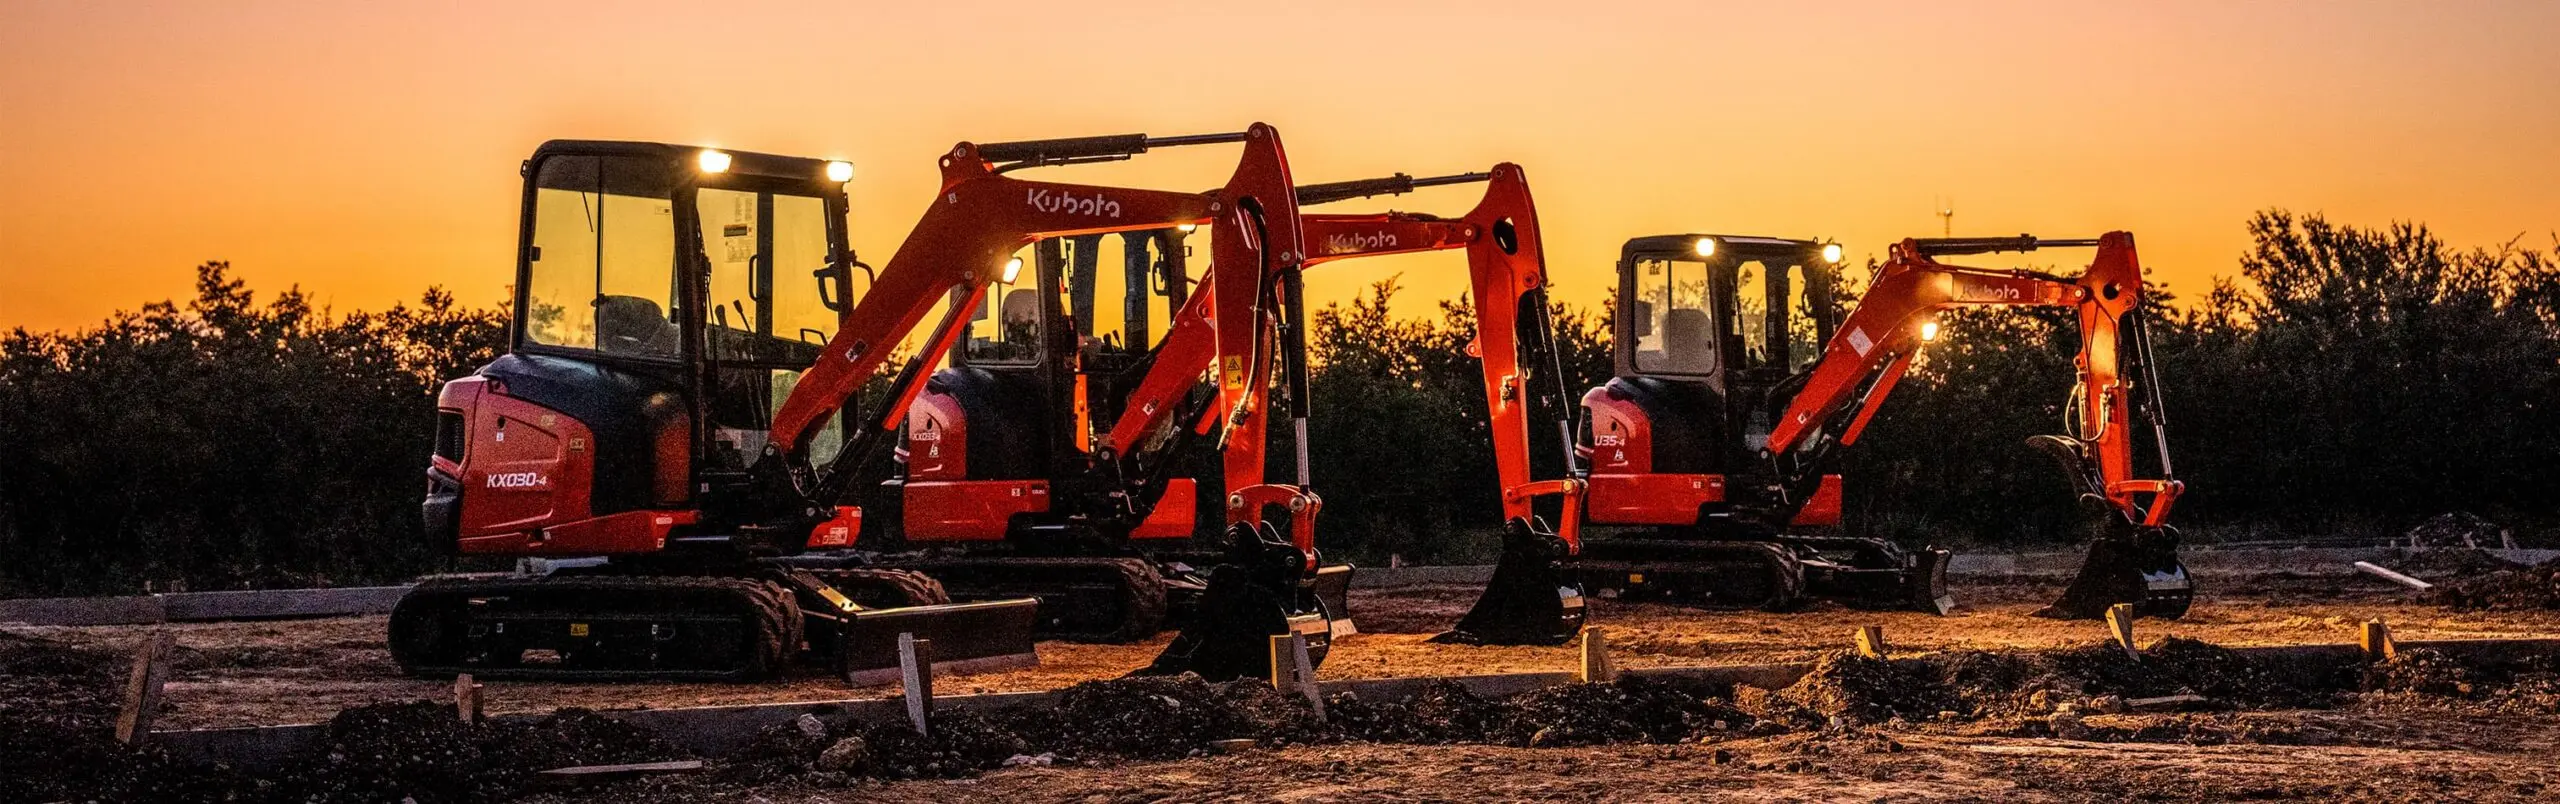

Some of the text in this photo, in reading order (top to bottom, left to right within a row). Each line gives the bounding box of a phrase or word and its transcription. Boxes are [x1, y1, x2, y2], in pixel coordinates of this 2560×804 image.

[1027, 188, 1120, 218] Kubota
[1329, 230, 1397, 249] Kubota
[1594, 435, 1625, 447] U35-4
[486, 472, 547, 488] KX030-4
